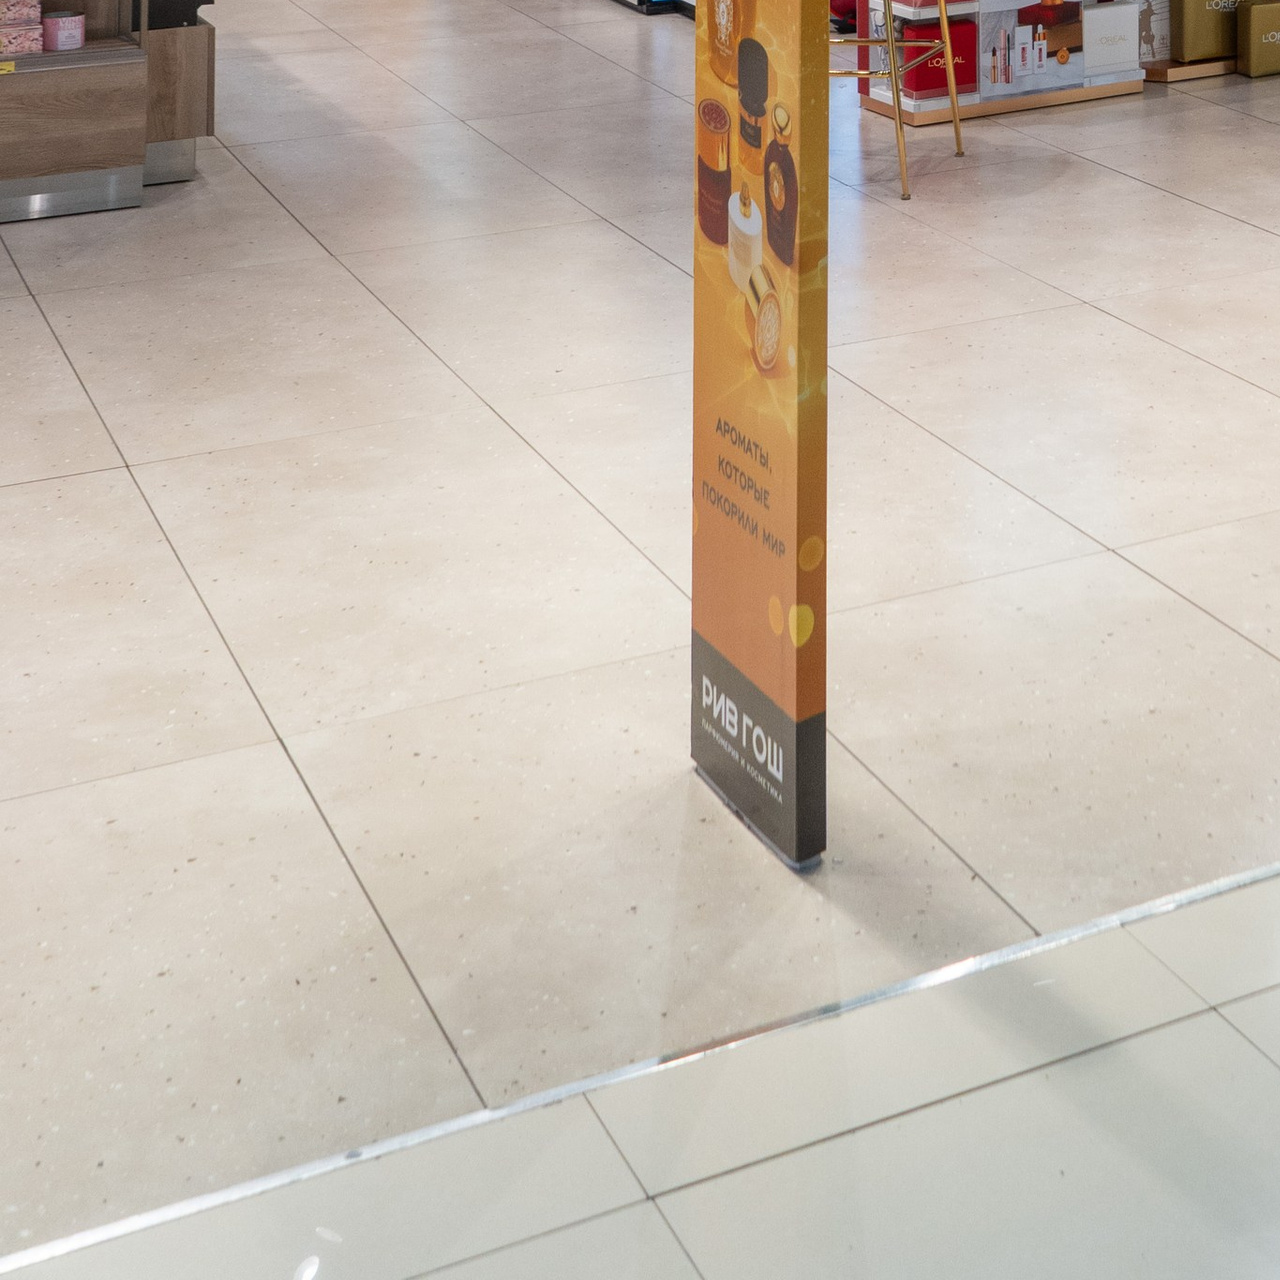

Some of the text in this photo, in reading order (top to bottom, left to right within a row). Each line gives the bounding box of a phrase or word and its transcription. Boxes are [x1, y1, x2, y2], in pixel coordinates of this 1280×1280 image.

[716, 417, 772, 474] АРОМАТЫ,
[718, 455, 770, 510] КОТОРЫЕ
[702, 480, 786, 558] ПОКОРИЛИ МИР
[702, 674, 784, 784] РИВ ГОШ
